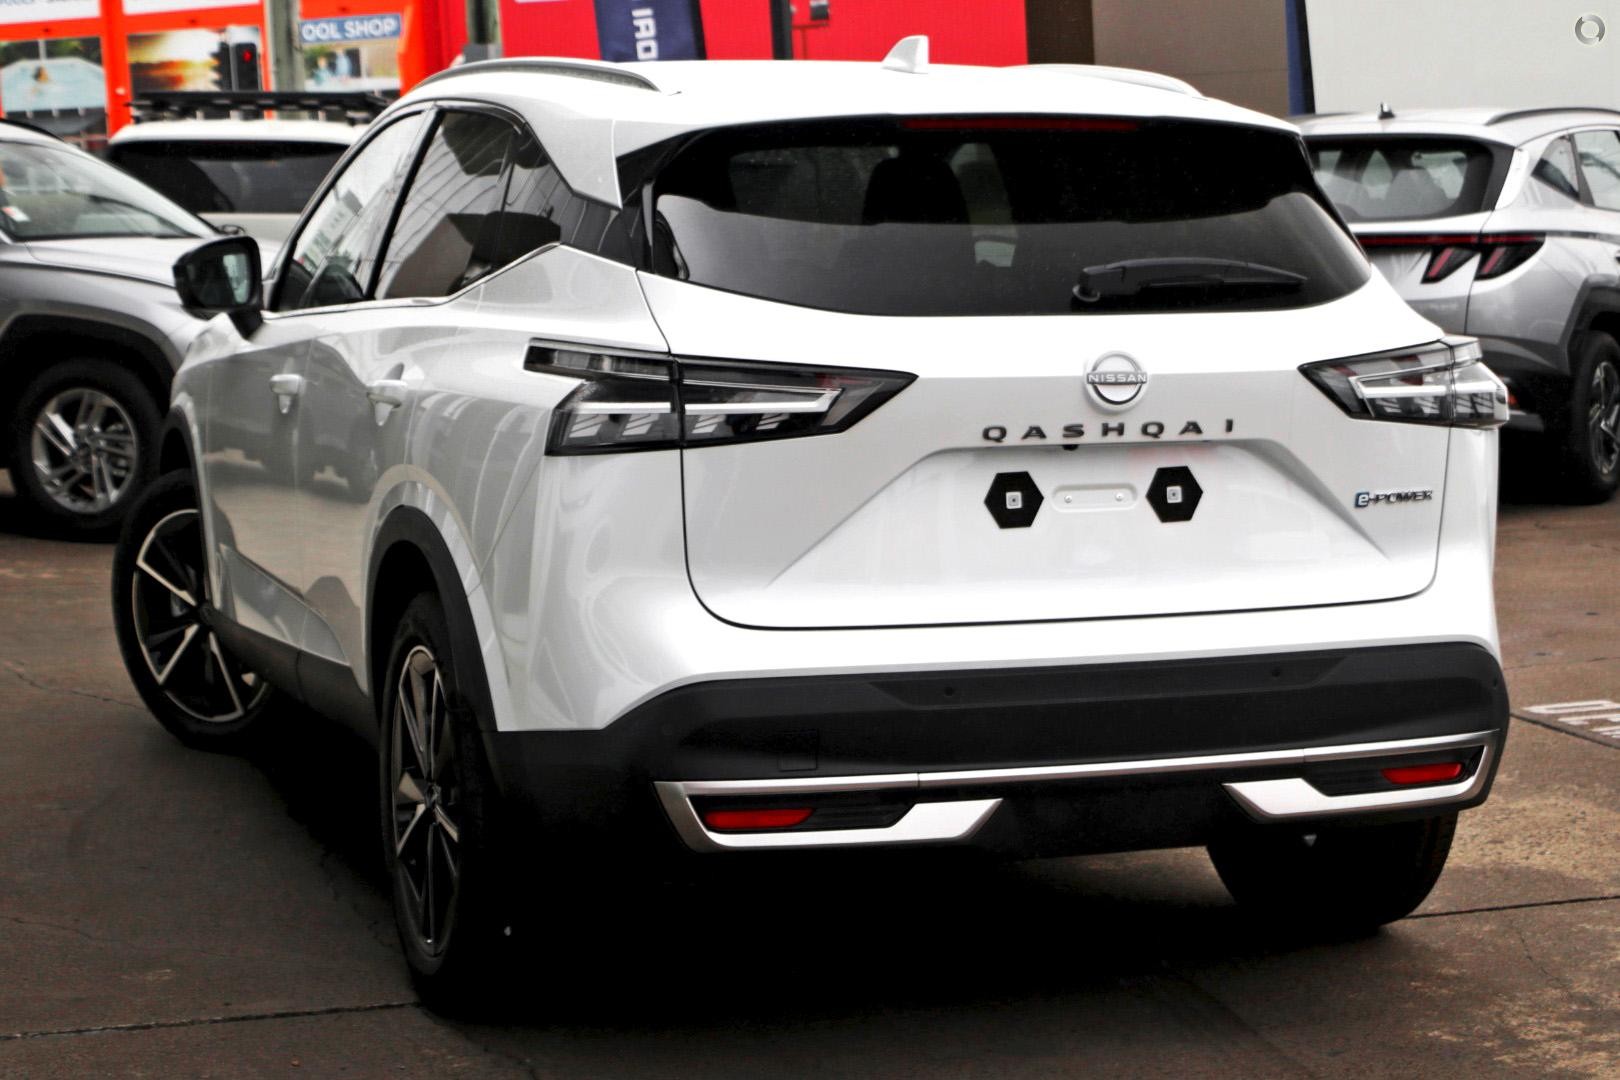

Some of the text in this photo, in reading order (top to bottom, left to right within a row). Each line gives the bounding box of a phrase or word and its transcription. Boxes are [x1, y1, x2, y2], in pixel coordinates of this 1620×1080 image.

[343, 17, 397, 38] SHOP
[1087, 373, 1147, 383] NISSAN
[982, 418, 1234, 443] QASHQAI
